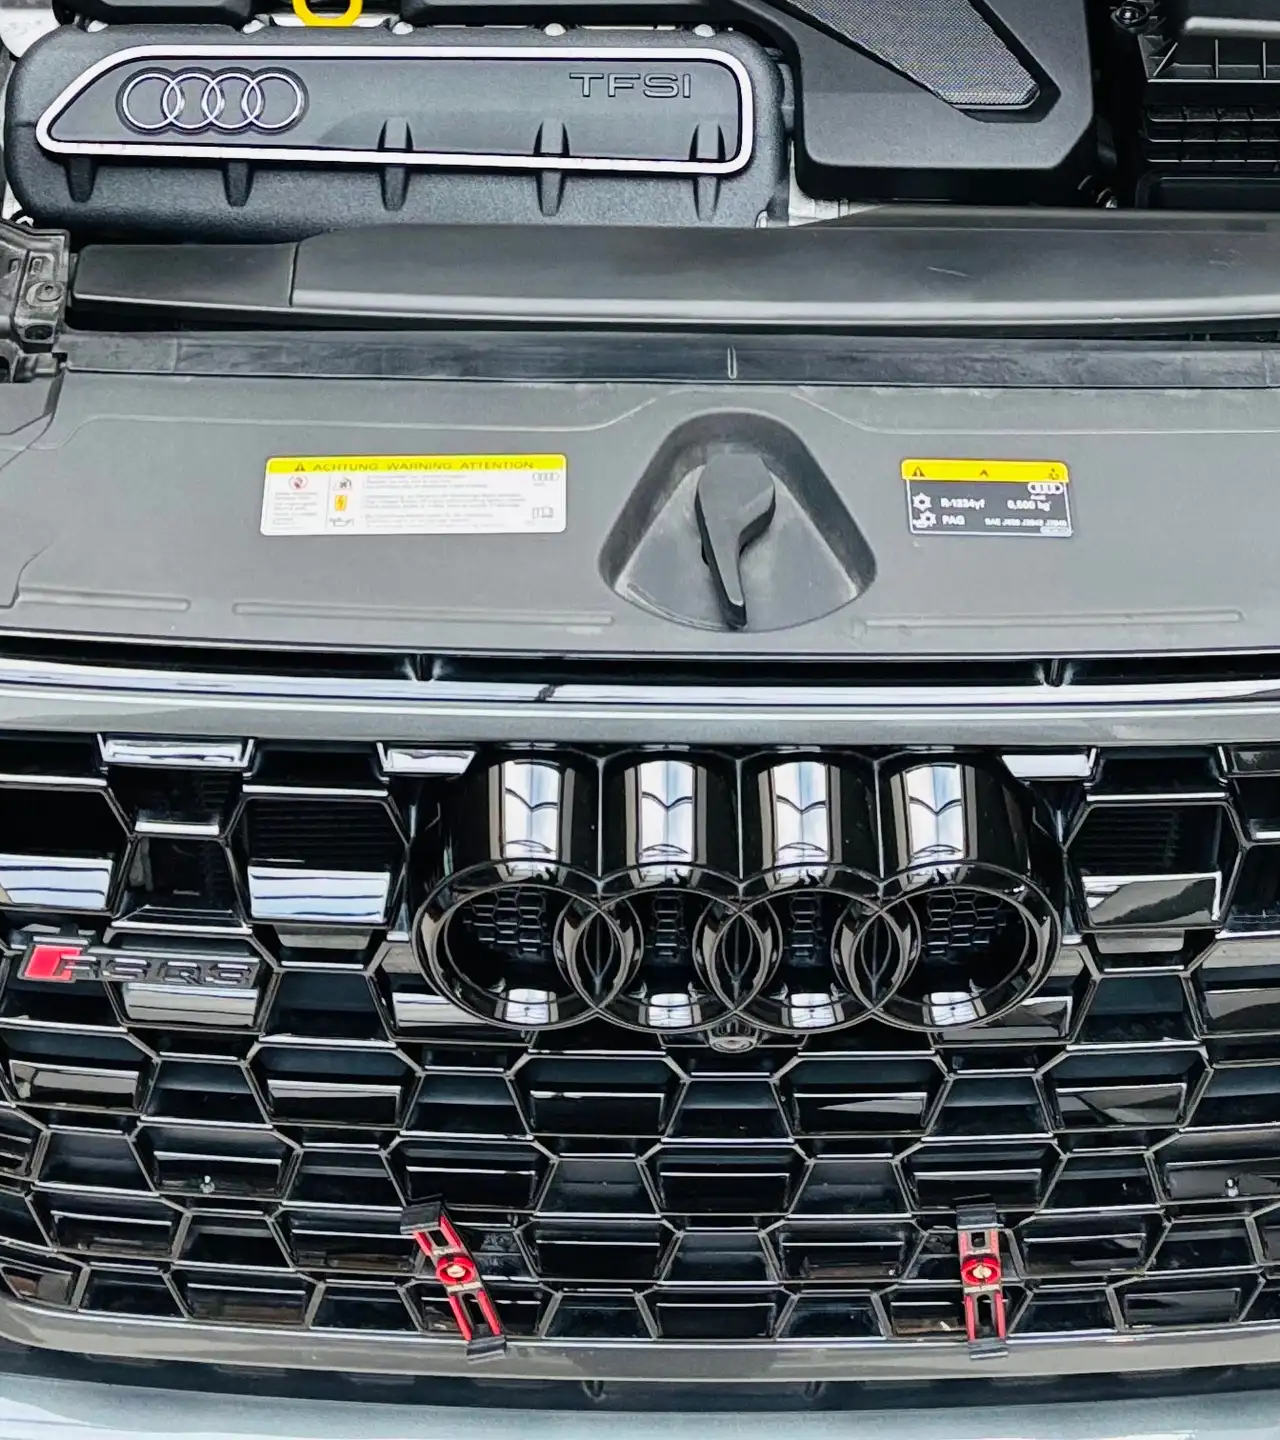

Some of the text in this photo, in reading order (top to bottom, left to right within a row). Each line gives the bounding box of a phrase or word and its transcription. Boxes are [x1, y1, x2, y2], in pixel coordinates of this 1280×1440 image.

[569, 72, 692, 99] TFSI
[312, 459, 535, 473] ACHTUNG WARNING ATTENTION
[42, 951, 151, 981] RS
